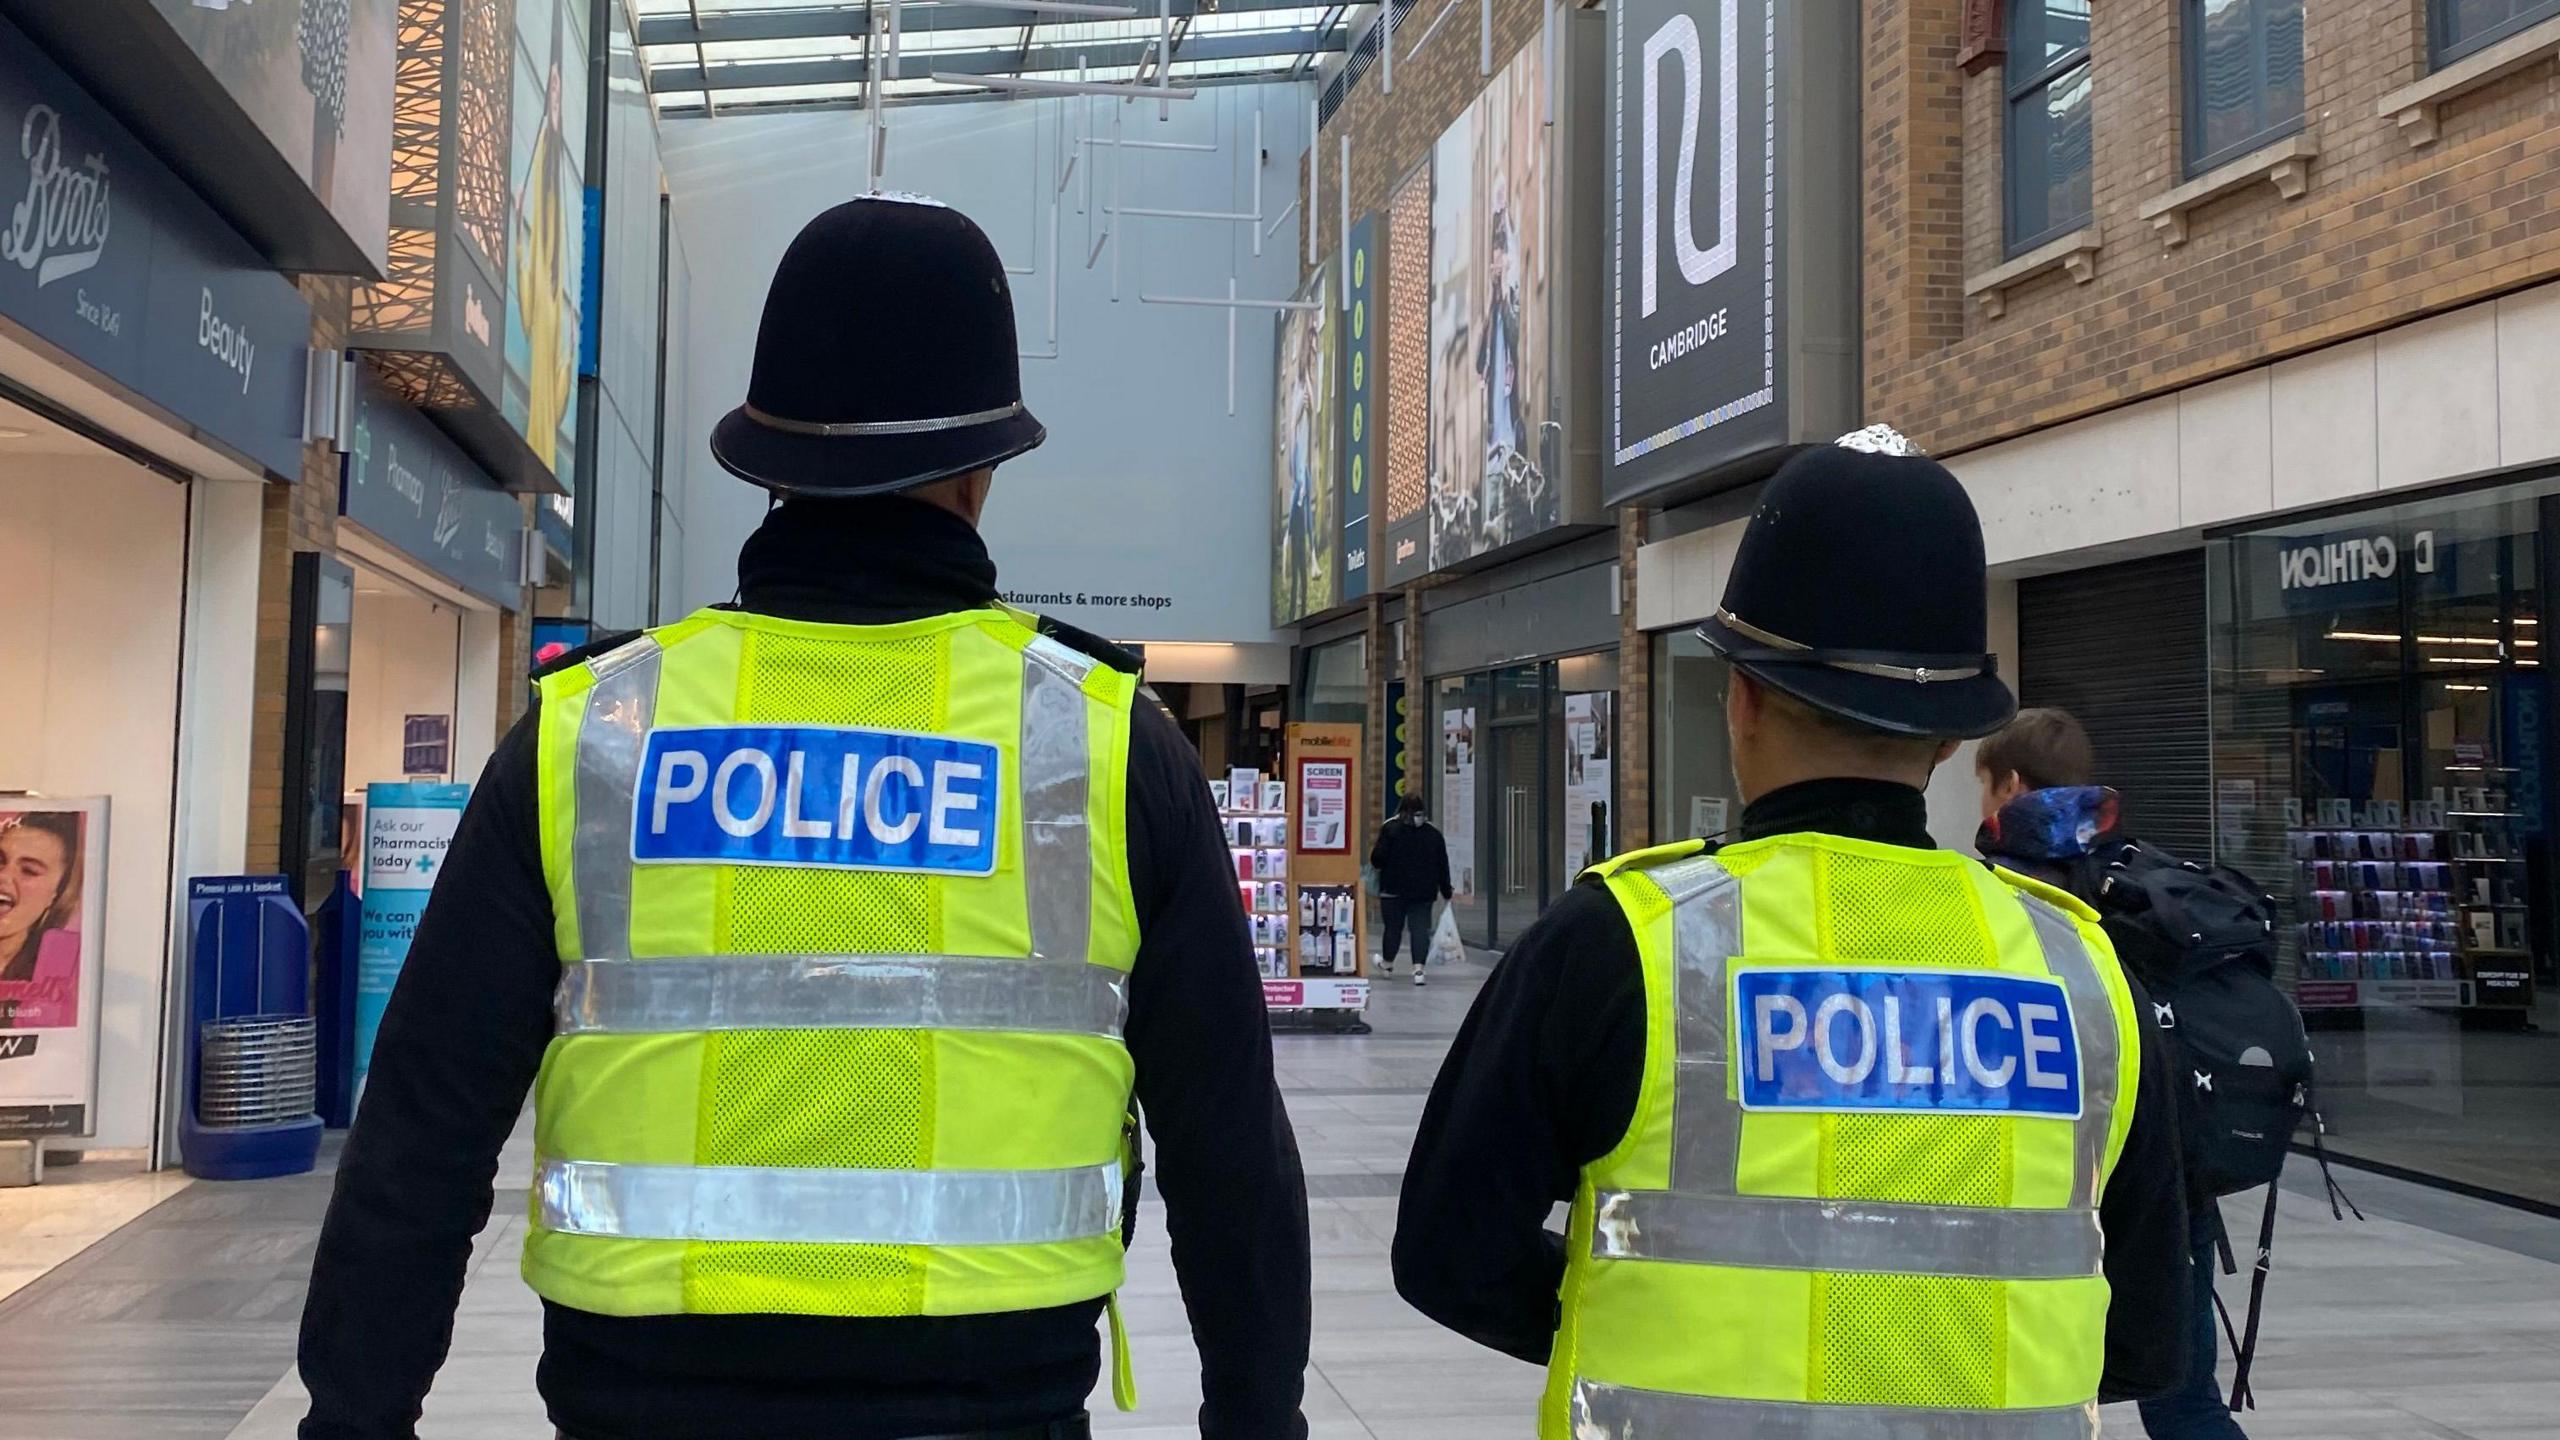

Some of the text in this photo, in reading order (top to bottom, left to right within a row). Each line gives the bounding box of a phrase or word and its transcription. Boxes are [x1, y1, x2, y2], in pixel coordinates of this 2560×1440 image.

[2, 104, 110, 288] Boots
[198, 286, 255, 394] Beauty
[1650, 307, 1728, 370] CAMBRIDGE
[1347, 547, 1366, 572] Toilets
[1001, 590, 1172, 611] staurants & more shops
[1306, 767, 1343, 777] SCREEN
[651, 748, 983, 847] POLICE
[374, 819, 424, 832] Ask our
[373, 836, 452, 849] Pharmacist
[372, 854, 412, 871] today
[363, 908, 415, 923] We can
[362, 928, 385, 943] you
[1755, 993, 2068, 1090] POLICE
